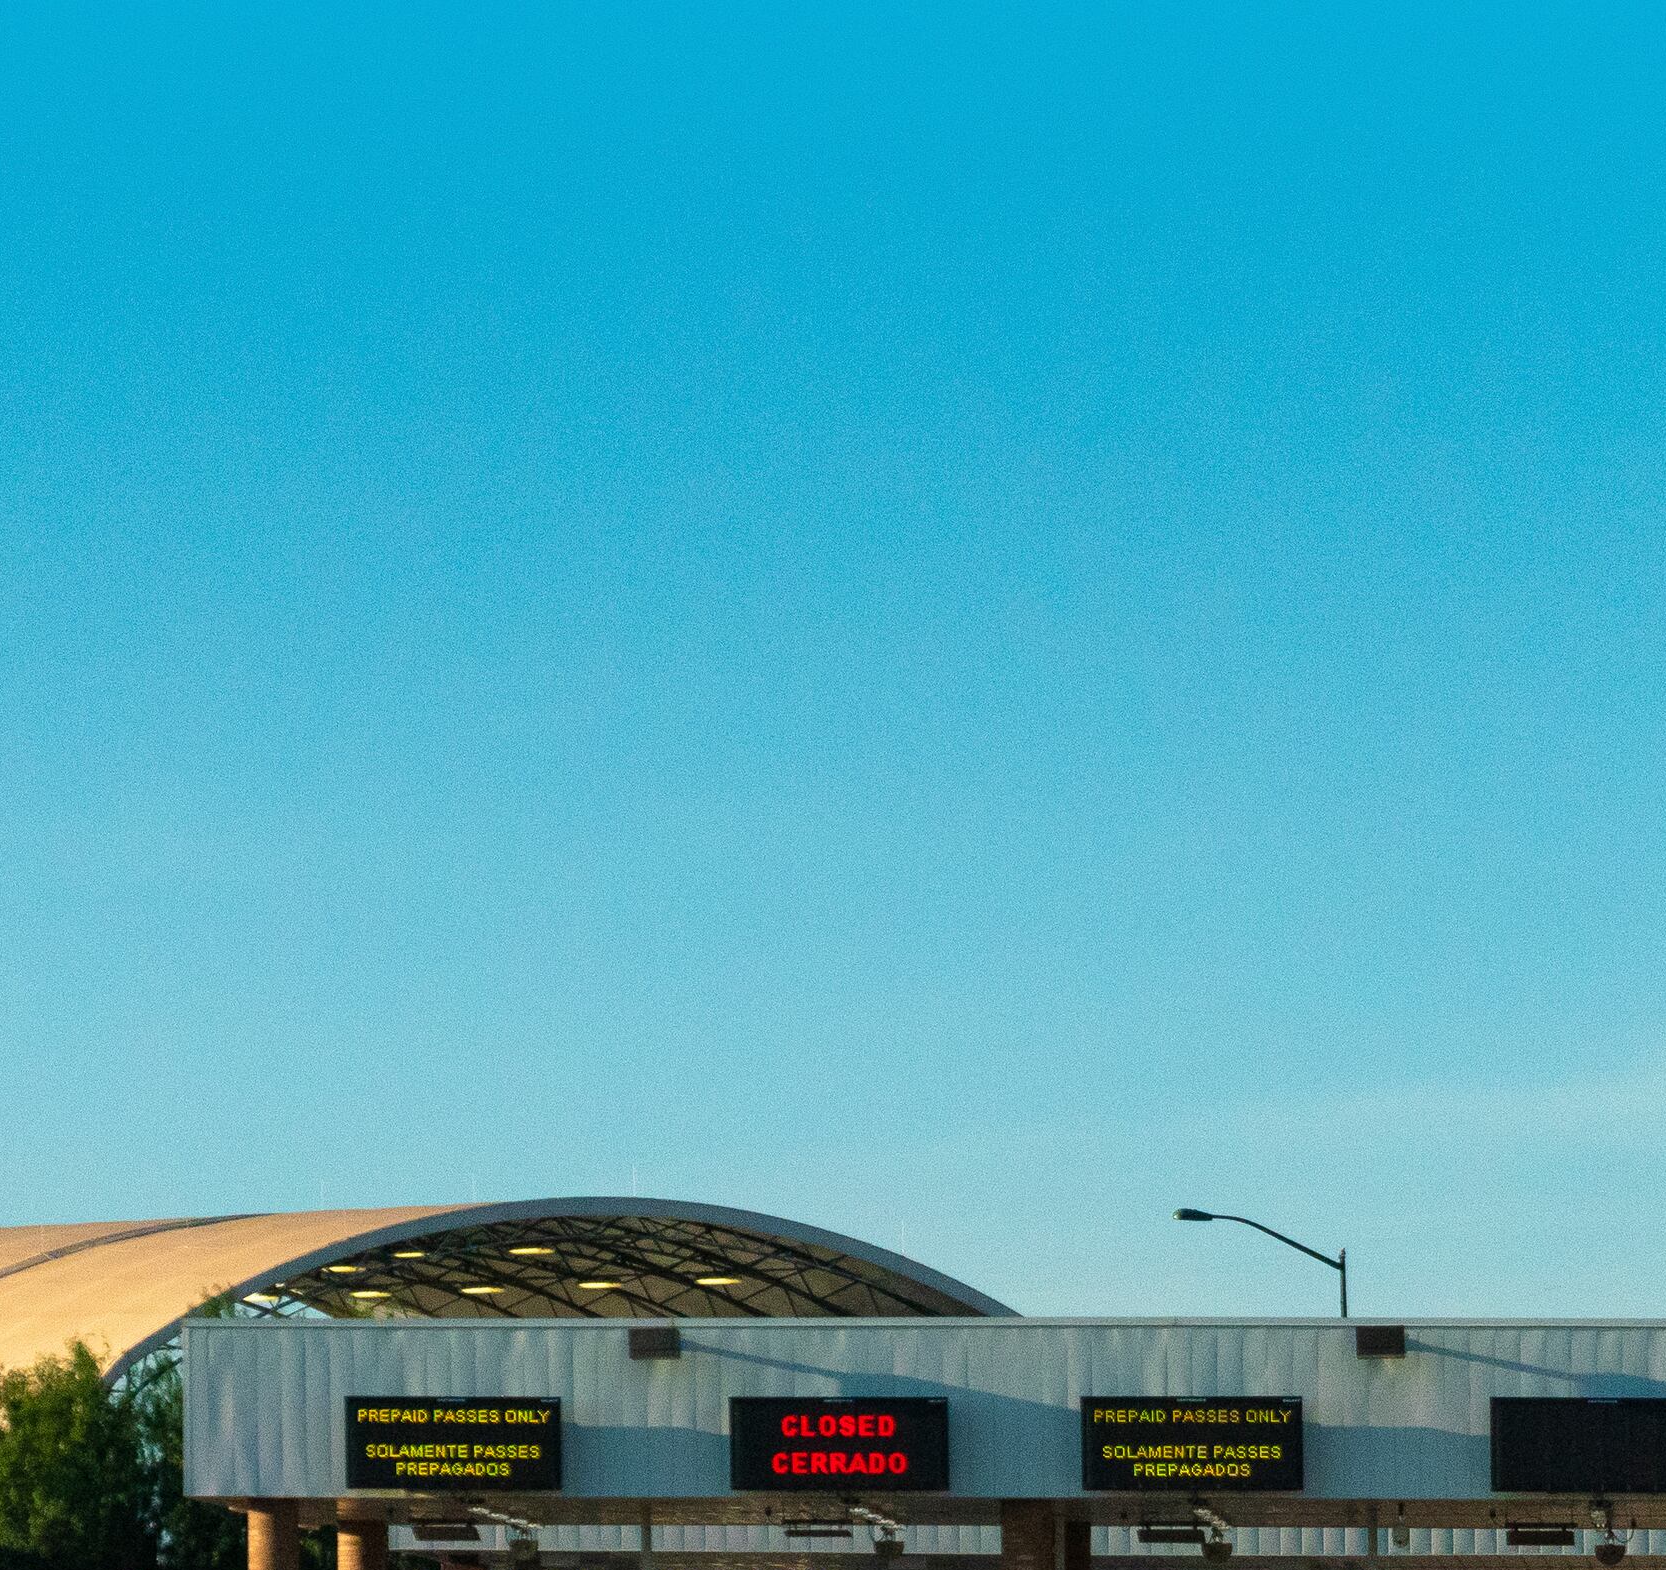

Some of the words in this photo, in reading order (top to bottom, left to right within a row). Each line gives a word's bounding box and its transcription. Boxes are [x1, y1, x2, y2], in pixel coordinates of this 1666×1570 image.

[357, 1409, 428, 1423] PREPAID
[433, 1409, 500, 1423] PASSES
[504, 1410, 551, 1424] ONLY
[1093, 1409, 1166, 1423] PREPAID
[1172, 1410, 1240, 1423] PASSES
[1245, 1410, 1292, 1423] ONLY
[781, 1414, 897, 1438] CLOSED
[365, 1444, 469, 1458] SOLAMENTE
[473, 1444, 540, 1459] PASSES
[1102, 1445, 1208, 1459] SOLAMENTE
[1213, 1445, 1281, 1459] PASSES
[395, 1462, 511, 1477] PREPAGADOS
[771, 1452, 909, 1474] CERRADO
[1133, 1463, 1251, 1477] PREPAGADOS
